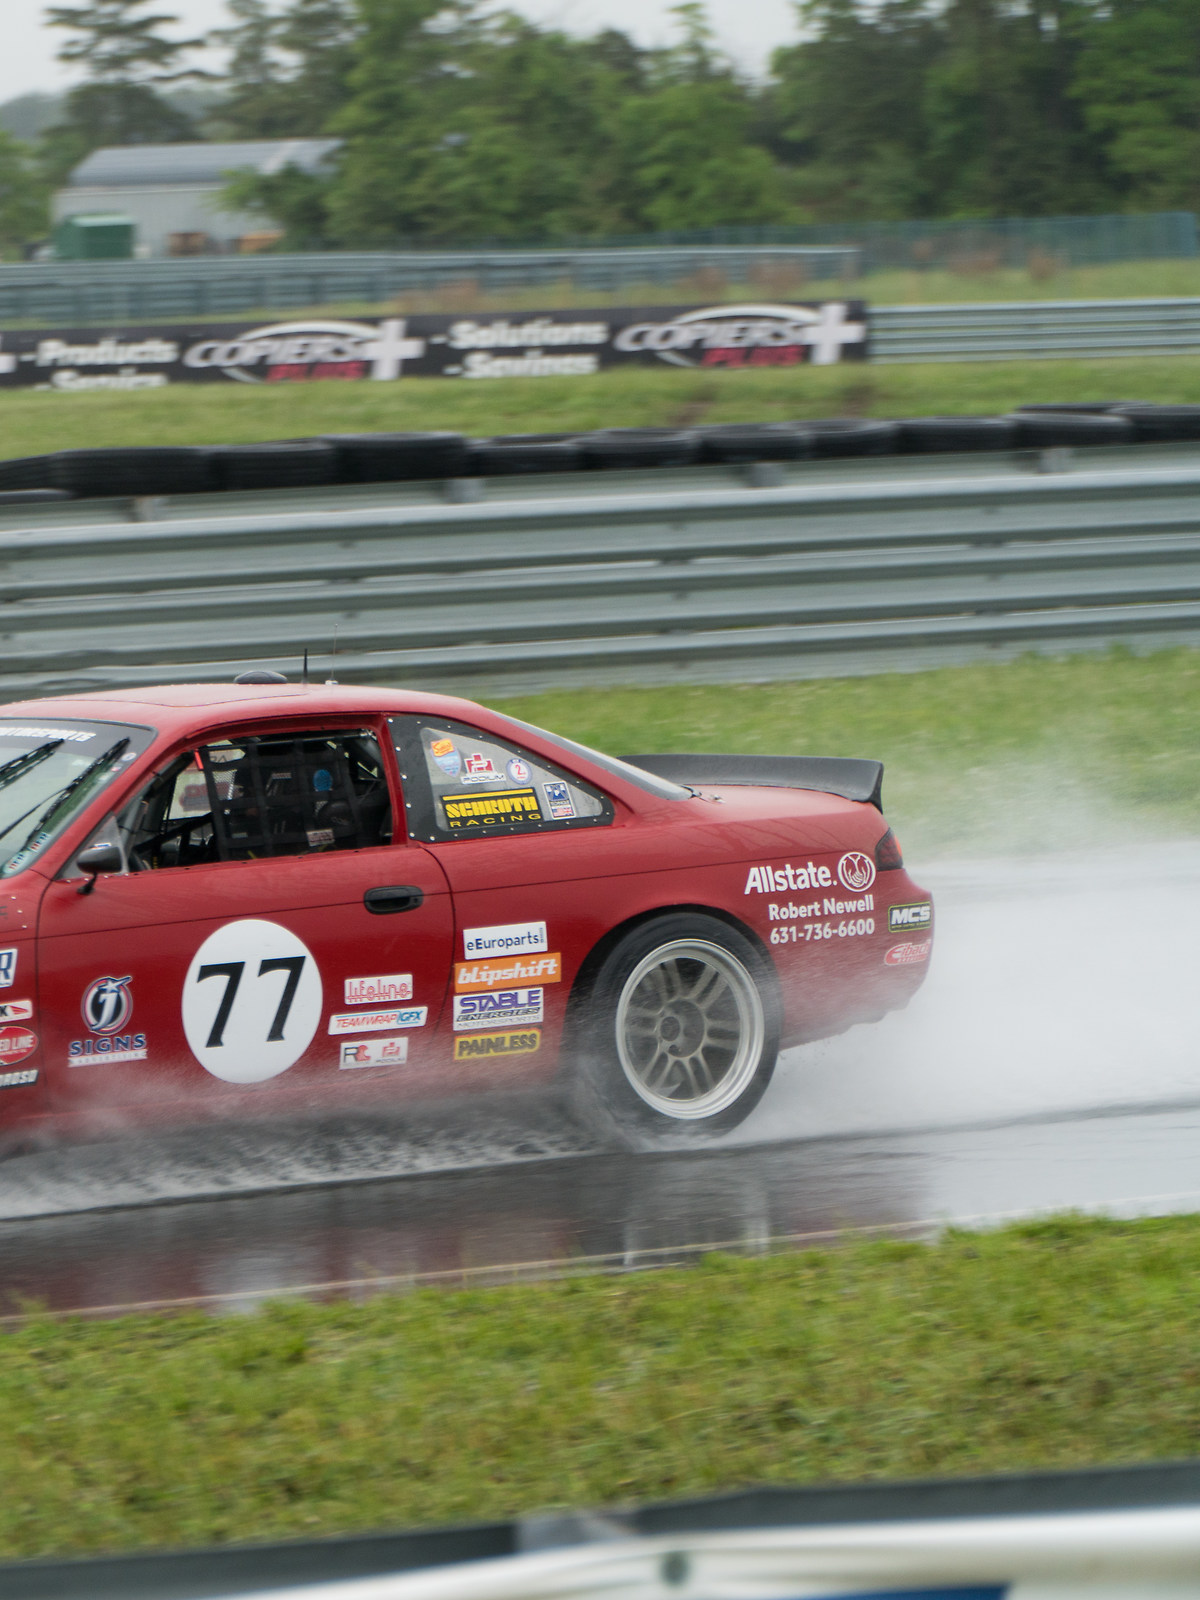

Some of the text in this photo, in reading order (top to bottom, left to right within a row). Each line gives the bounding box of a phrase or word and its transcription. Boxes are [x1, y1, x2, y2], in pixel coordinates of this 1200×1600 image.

[614, 317, 804, 351] COPIERS
[182, 336, 364, 367] COPIERS
[445, 796, 539, 819] SCHROTH
[450, 813, 542, 828] RACING
[768, 894, 874, 921] Robert Newell
[891, 905, 930, 925] MCS
[466, 931, 539, 951] eEuroparts
[769, 917, 875, 945] 631-736-6600
[457, 958, 558, 986] blipshift
[196, 955, 307, 1049] 77
[348, 979, 411, 1003] lifeline
[459, 989, 541, 1015] STABLE
[456, 1006, 541, 1023] ENERGIES
[11, 1034, 35, 1051] LINE
[69, 1033, 147, 1056] SIGNS
[457, 1032, 537, 1058] PAINLESS
